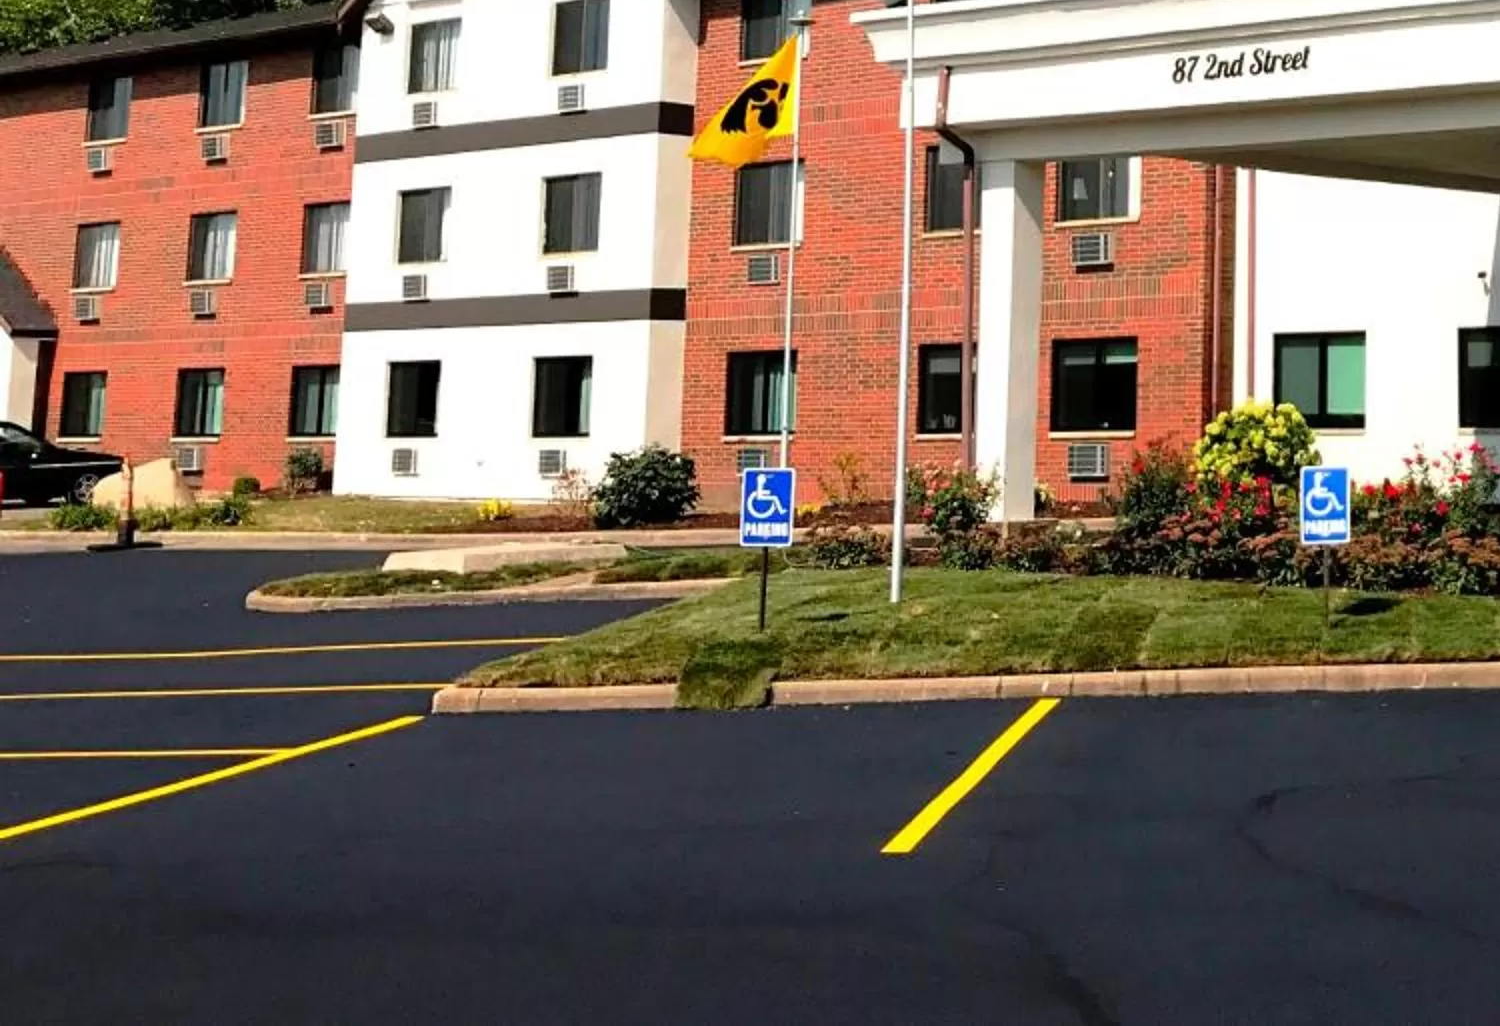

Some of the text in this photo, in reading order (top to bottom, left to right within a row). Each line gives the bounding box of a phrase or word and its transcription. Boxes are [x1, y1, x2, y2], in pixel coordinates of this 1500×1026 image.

[1172, 45, 1310, 84] 87 2nd Street
